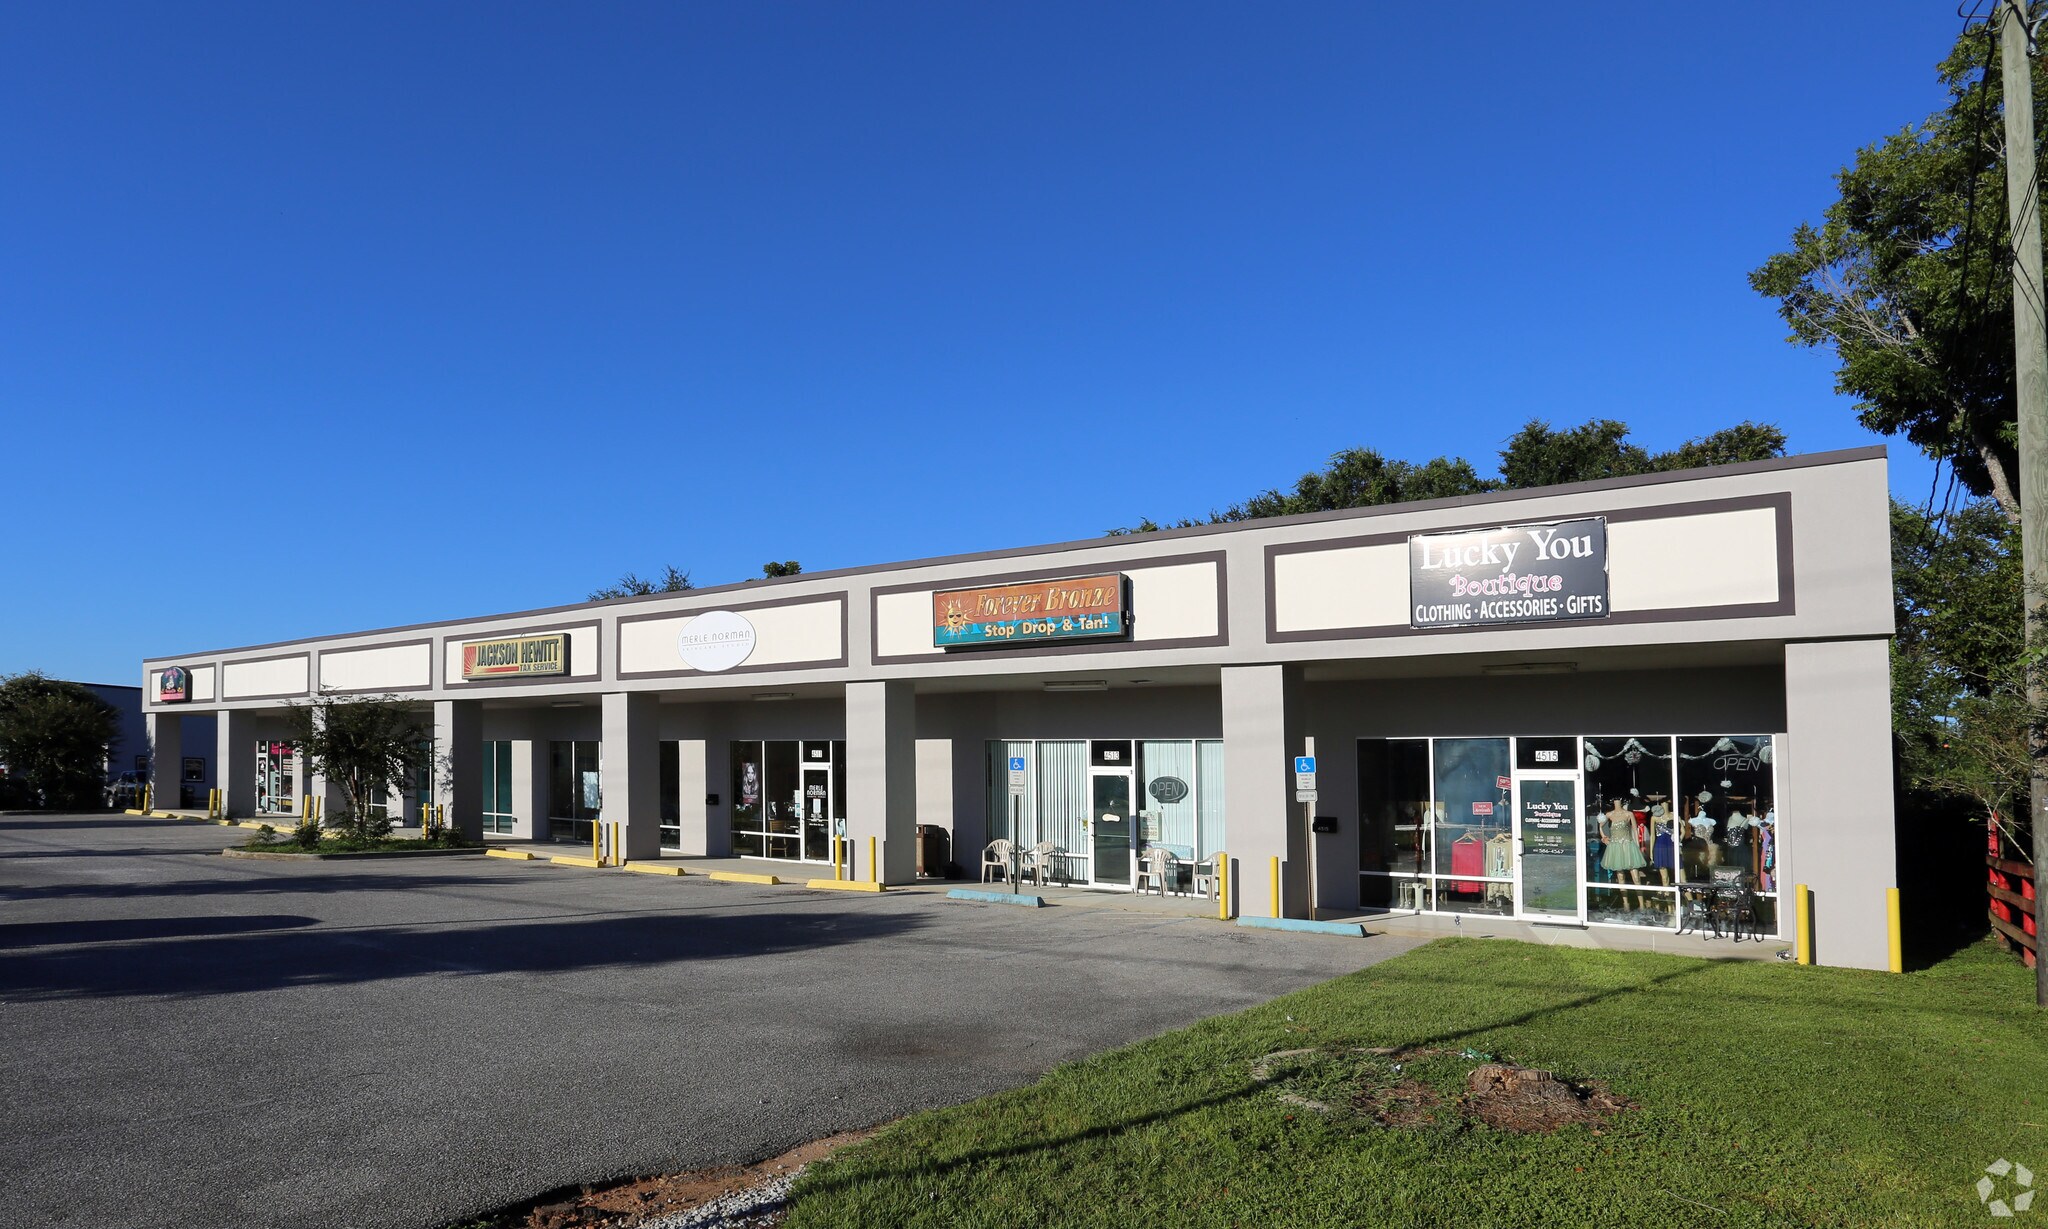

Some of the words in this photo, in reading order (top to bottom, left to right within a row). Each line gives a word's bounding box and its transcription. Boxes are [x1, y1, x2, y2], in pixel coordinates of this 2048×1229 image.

[1420, 533, 1520, 573] Lucky
[1527, 529, 1594, 561] You
[1449, 573, 1563, 598] Boutique
[974, 592, 1043, 617] Forever
[1045, 585, 1116, 612] Bronze
[1415, 603, 1471, 622] CLOTHING
[1480, 598, 1558, 619] ACCESSORIES
[1566, 595, 1602, 615] GIFTS
[985, 624, 1015, 639] Stop
[1022, 621, 1056, 636] Drop
[1062, 619, 1073, 632] &
[1079, 616, 1108, 630] Tan!
[682, 633, 708, 644] MERLE
[712, 630, 750, 641] NORMAN
[477, 642, 518, 667] JACKSON
[521, 639, 559, 664] HEWITT
[520, 664, 531, 672] TAX
[533, 662, 558, 671] SERVICE
[1536, 751, 1558, 761] 4515
[1713, 757, 1760, 771] OPEN
[1150, 782, 1180, 796] OPEN
[1526, 802, 1551, 811] Lucky
